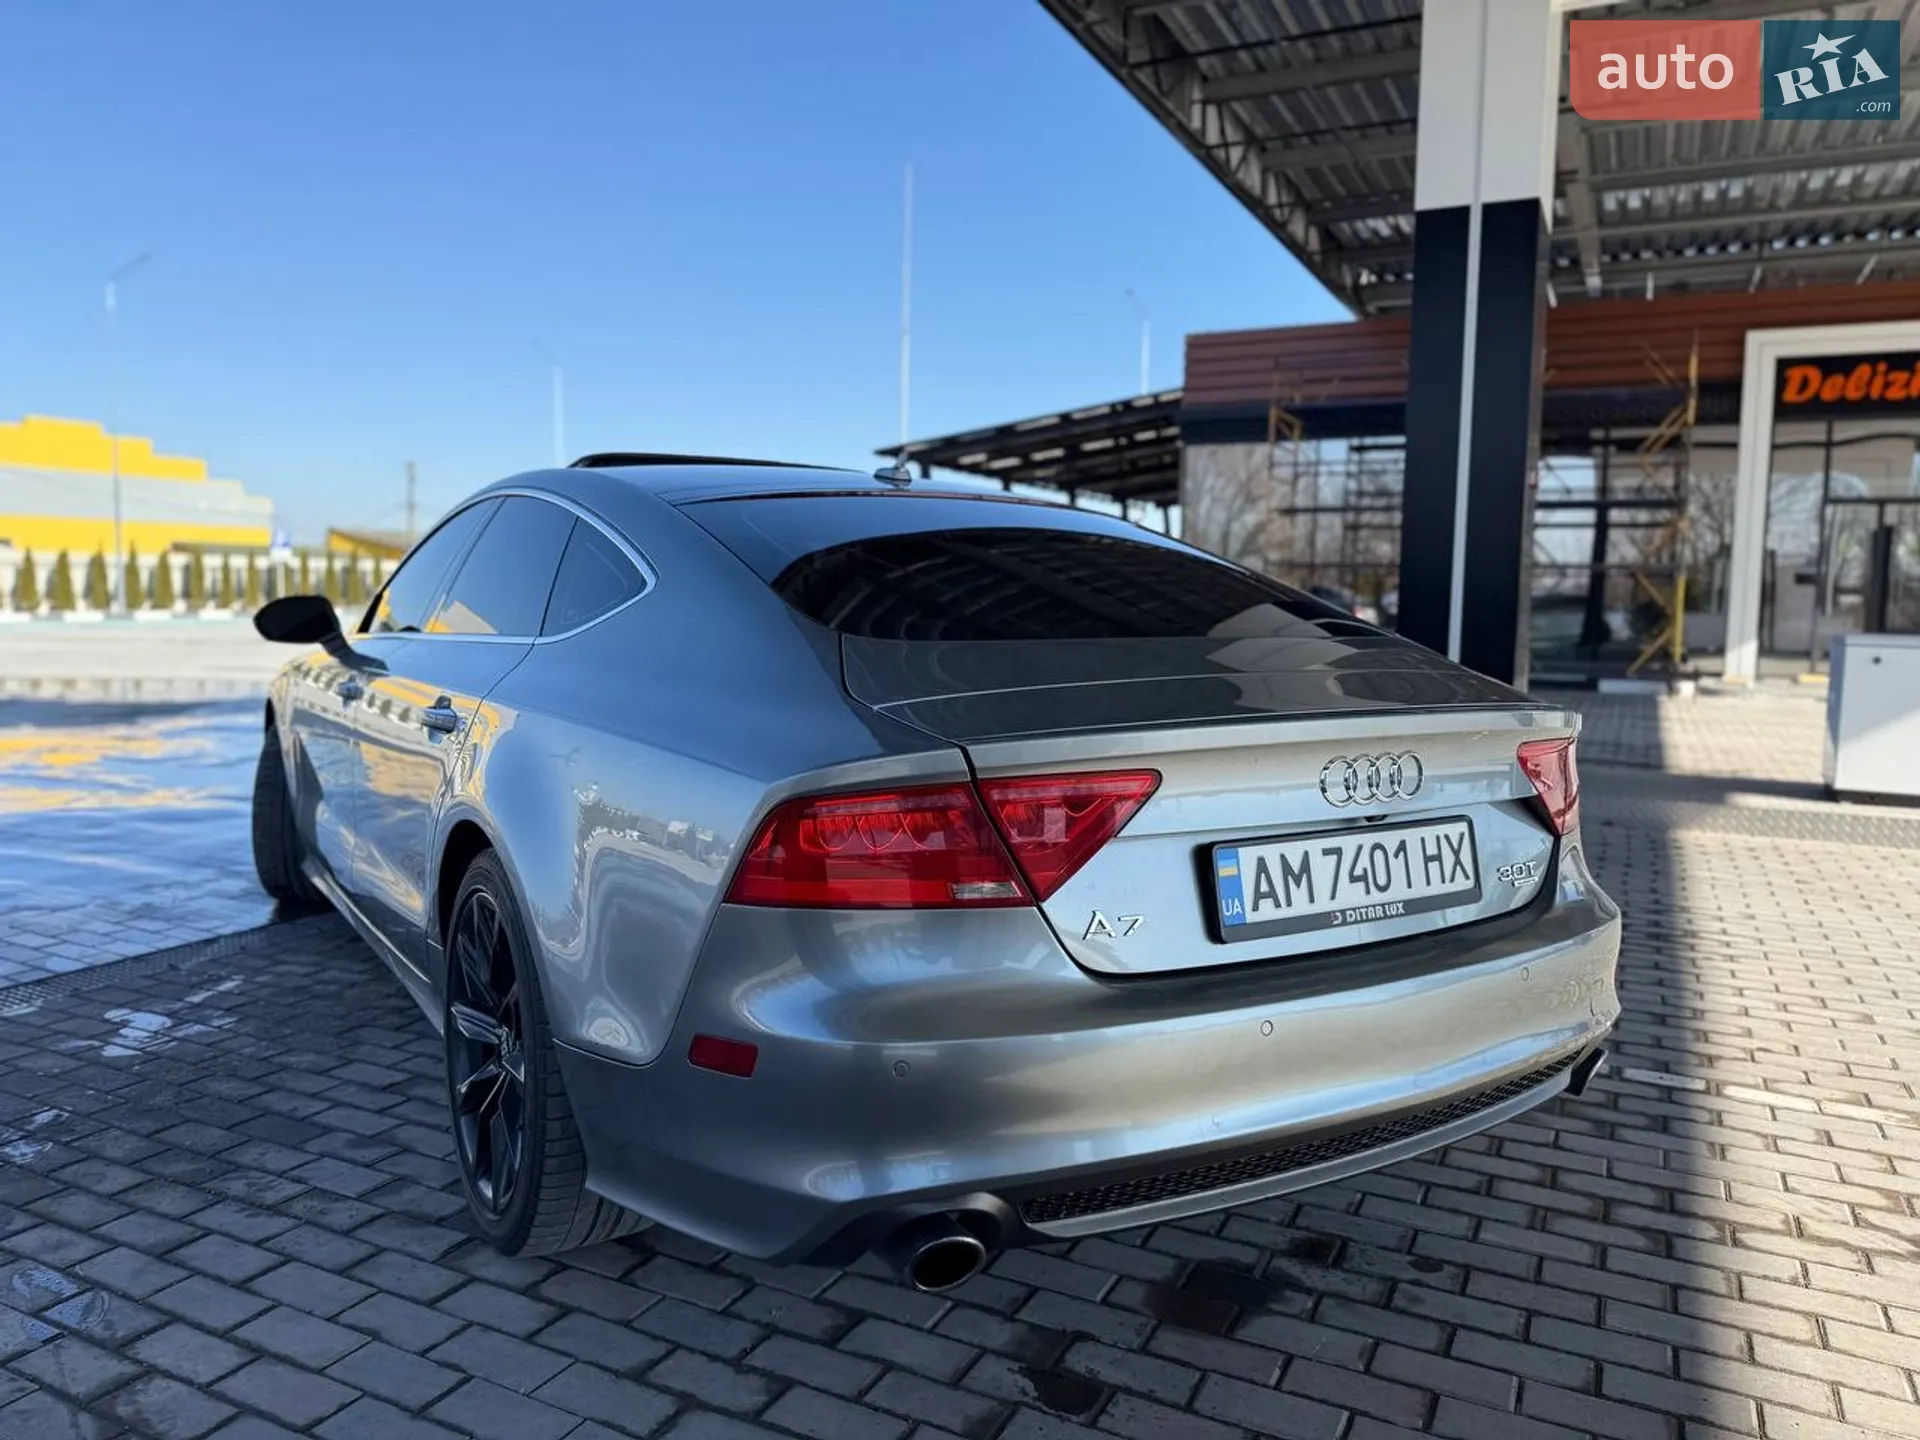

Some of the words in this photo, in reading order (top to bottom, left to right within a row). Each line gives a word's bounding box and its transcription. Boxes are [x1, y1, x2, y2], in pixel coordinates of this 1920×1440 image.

[1251, 849, 1316, 913] AM
[1321, 838, 1413, 902] 7401
[1419, 831, 1471, 888] HX
[1222, 898, 1243, 917] UA
[1345, 905, 1385, 923] DITAR
[1384, 901, 1406, 917] LUX
[1082, 909, 1145, 940] A7
